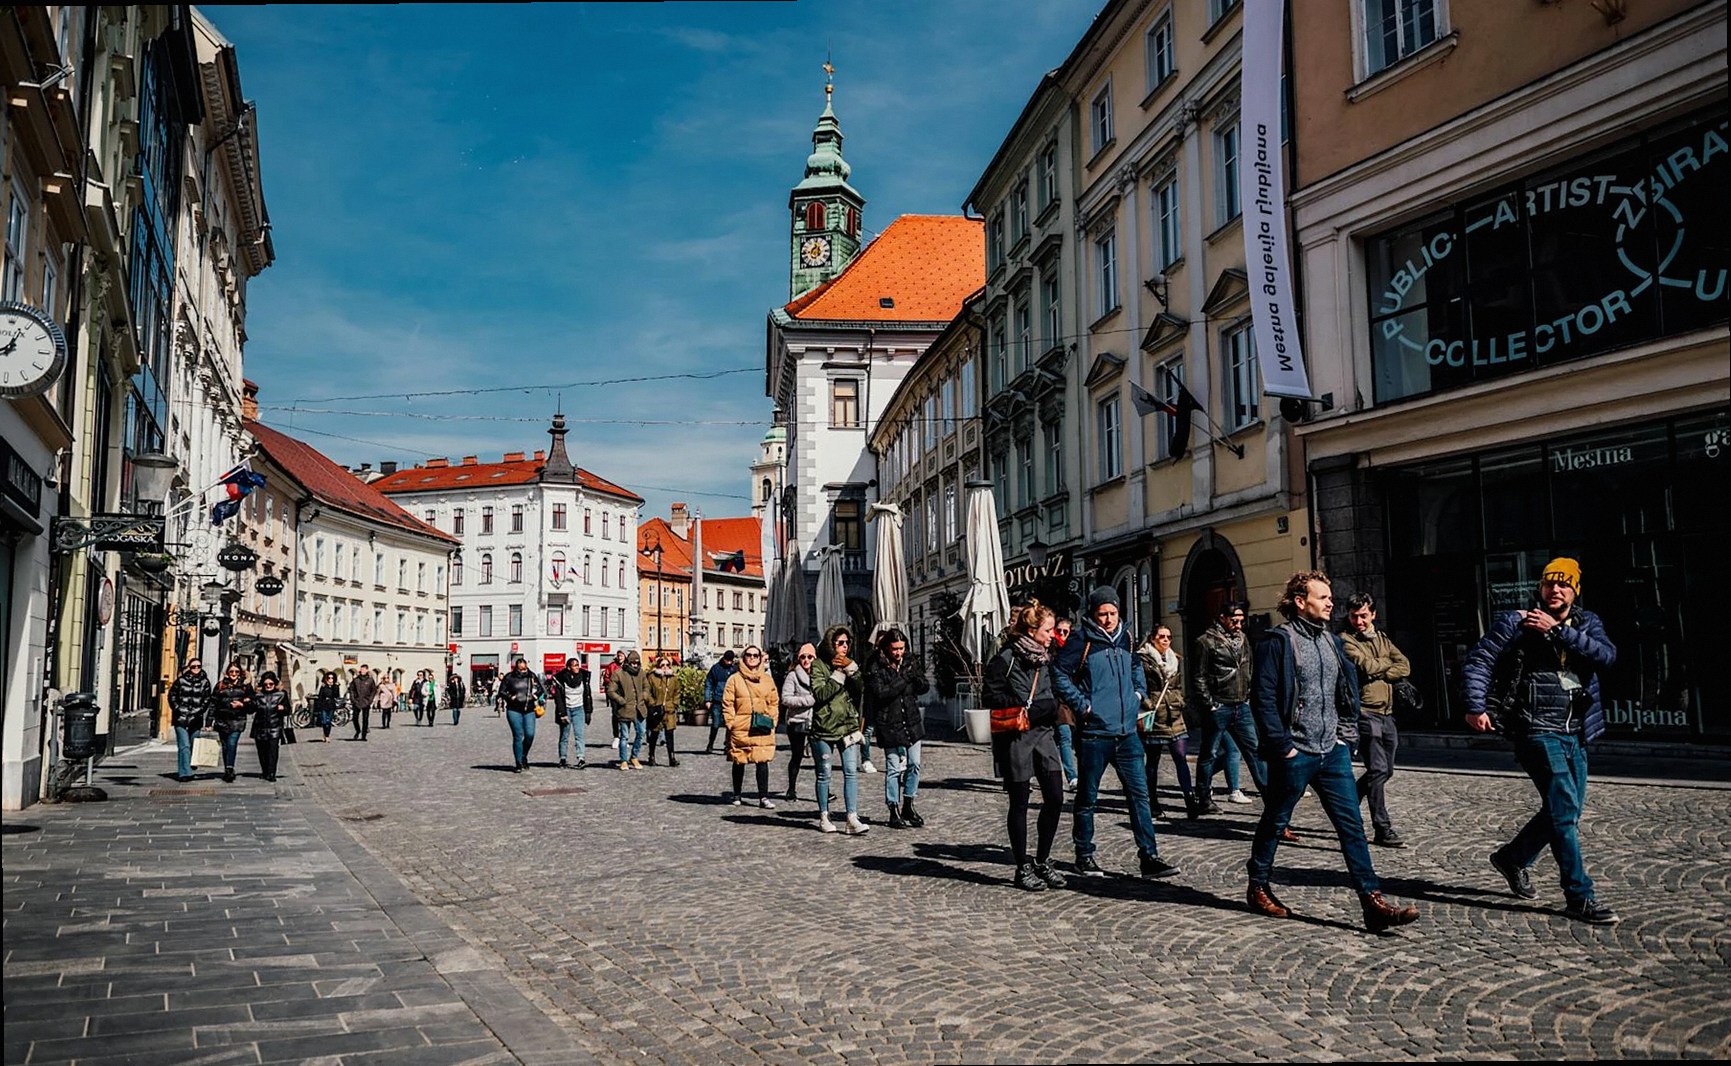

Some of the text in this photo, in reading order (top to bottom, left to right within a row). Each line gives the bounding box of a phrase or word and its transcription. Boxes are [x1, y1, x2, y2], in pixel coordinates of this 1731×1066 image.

[1380, 175, 1633, 368] PUBLIC ARTIST COLLECTOR
[1553, 446, 1635, 473] Mestna
[1004, 552, 1065, 589] OTOVŽ
[1603, 699, 1690, 733] ubljana
